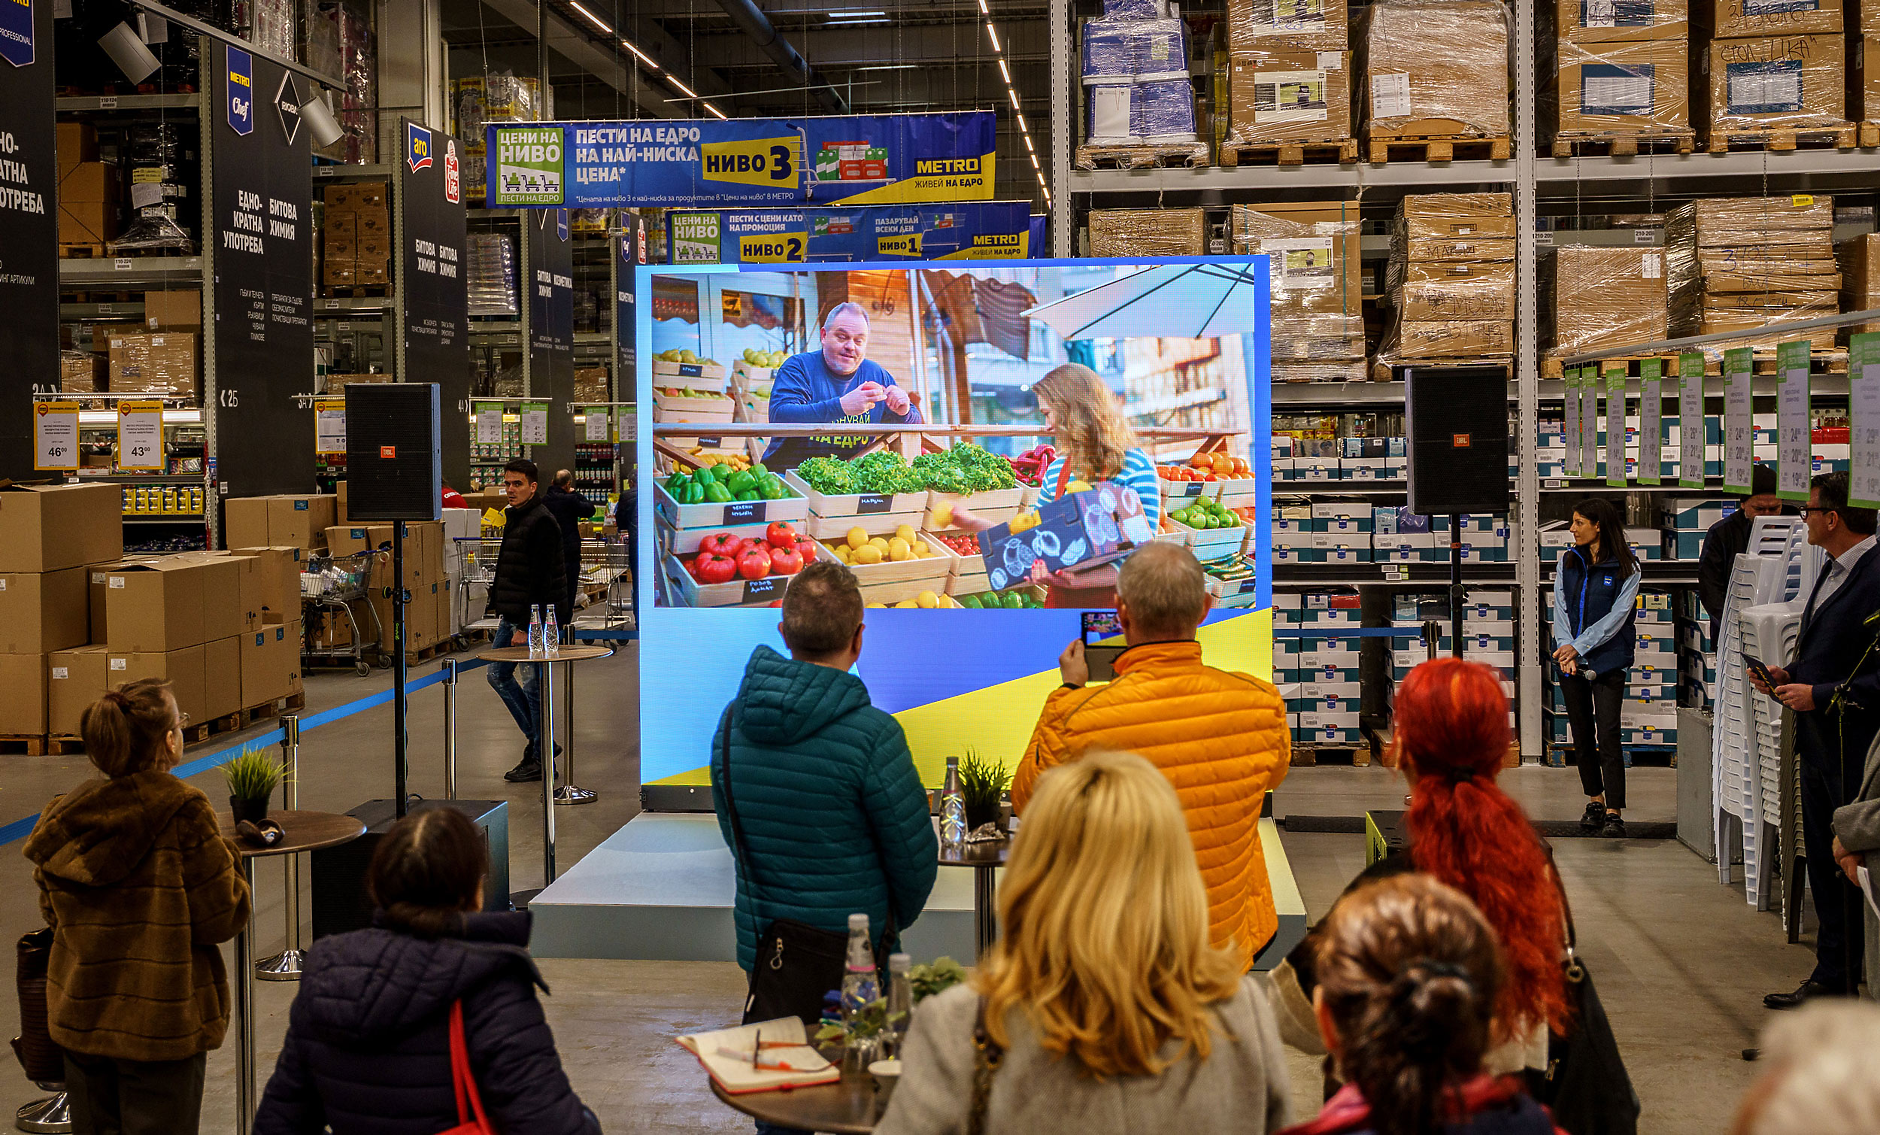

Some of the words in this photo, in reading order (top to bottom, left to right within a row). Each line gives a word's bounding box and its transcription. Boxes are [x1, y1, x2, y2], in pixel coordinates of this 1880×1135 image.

[230, 71, 250, 87] METRO
[232, 97, 249, 122] Chef
[500, 132, 537, 145] ЦЕНИ
[540, 132, 559, 143] НА
[576, 128, 626, 144] ПЕСТИ
[630, 128, 653, 143] НА
[656, 127, 700, 145] ЕДРО
[414, 137, 427, 157] aro
[500, 145, 560, 163] НИВО
[576, 148, 599, 163] НА
[602, 144, 699, 162] НАЙ-НИСКА
[707, 155, 765, 173] НИВО
[770, 145, 792, 180] 3
[917, 158, 979, 173] METRO
[914, 178, 944, 188] ЖИВЕЙ
[945, 179, 958, 188] НА
[959, 178, 983, 188] ЕДРО
[238, 189, 263, 212] ЕДНО-
[500, 195, 525, 203] ПЕСТИ
[526, 195, 537, 203] НА
[538, 194, 559, 203] ЕДРО
[627, 194, 631, 202] 3
[772, 192, 794, 200] МЕТРО
[269, 198, 298, 221] БИТОВА
[233, 210, 264, 233] КРАТНА
[674, 216, 702, 227] ЦЕНИ
[703, 216, 717, 225] НА
[729, 215, 754, 223] ПЕСТИ
[760, 215, 782, 223] ЦЕНИ
[782, 214, 804, 222] КАТО
[875, 216, 919, 226] ПАЗАРУВАЙ
[269, 219, 295, 240] ХИМИЯ
[674, 225, 718, 239] НИВО
[729, 224, 740, 232] НА
[741, 223, 786, 232] ПРОМОЦИЯ
[900, 225, 914, 233] ДЕН
[223, 230, 264, 255] УПОТРЕБА
[415, 239, 436, 257] БИТОВА
[879, 241, 907, 251] НИВО
[908, 238, 918, 253] 1
[973, 235, 1018, 245] METRO
[439, 245, 458, 262] БИТОВА
[743, 244, 784, 257] НИВО
[786, 238, 802, 261] 2
[972, 248, 993, 256] ЖИВЕЙ
[1003, 248, 1021, 256] ЕДРО
[417, 256, 436, 274] ХИМИЯ
[439, 261, 457, 279] ХИМИЯ
[228, 389, 239, 408] 2Б
[831, 410, 870, 424] НУВАЙ
